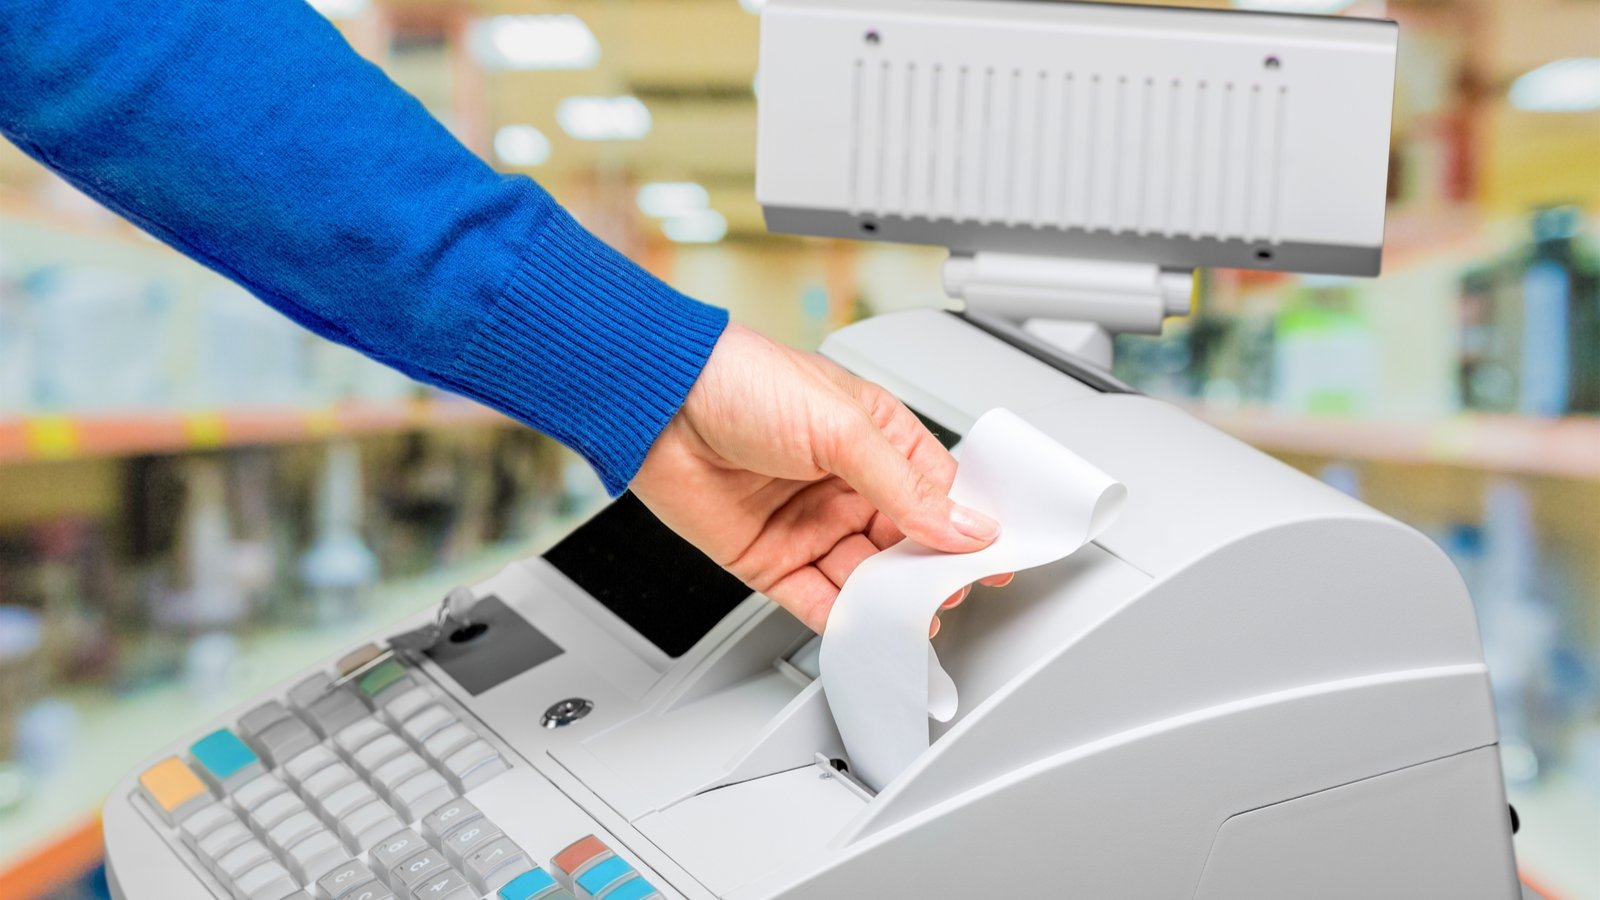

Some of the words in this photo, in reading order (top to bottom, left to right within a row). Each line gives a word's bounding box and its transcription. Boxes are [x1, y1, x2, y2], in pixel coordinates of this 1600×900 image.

[442, 808, 459, 820] 9
[460, 829, 480, 842] 8
[388, 840, 408, 852] 6
[485, 848, 504, 862] 7
[409, 858, 430, 872] 5
[335, 870, 354, 883] 3
[430, 879, 449, 892] 4
